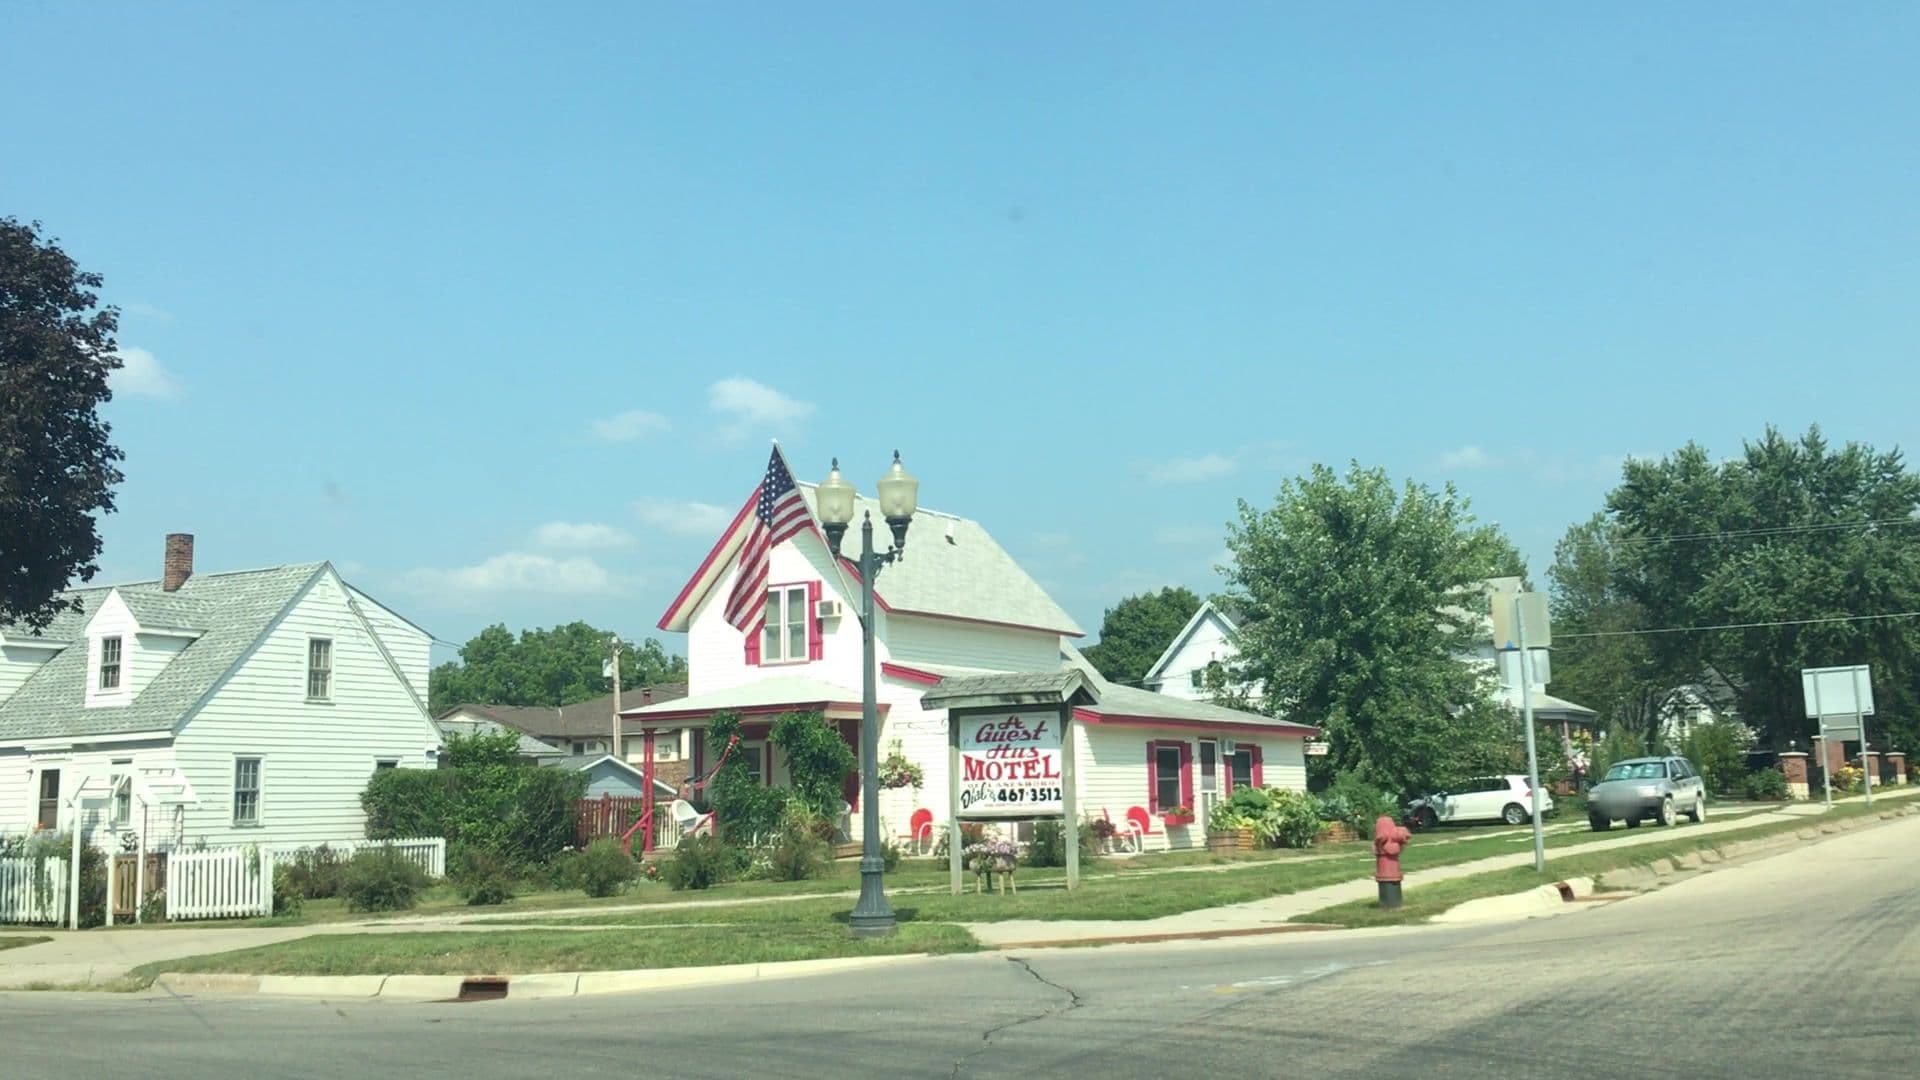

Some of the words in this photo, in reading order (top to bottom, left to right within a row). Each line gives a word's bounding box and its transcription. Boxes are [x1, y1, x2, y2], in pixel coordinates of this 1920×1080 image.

[975, 720, 1049, 744] Guest
[998, 715, 1025, 729] A
[986, 743, 1040, 760] Hus
[962, 754, 1061, 781] MOTEL
[960, 782, 987, 809] Dial
